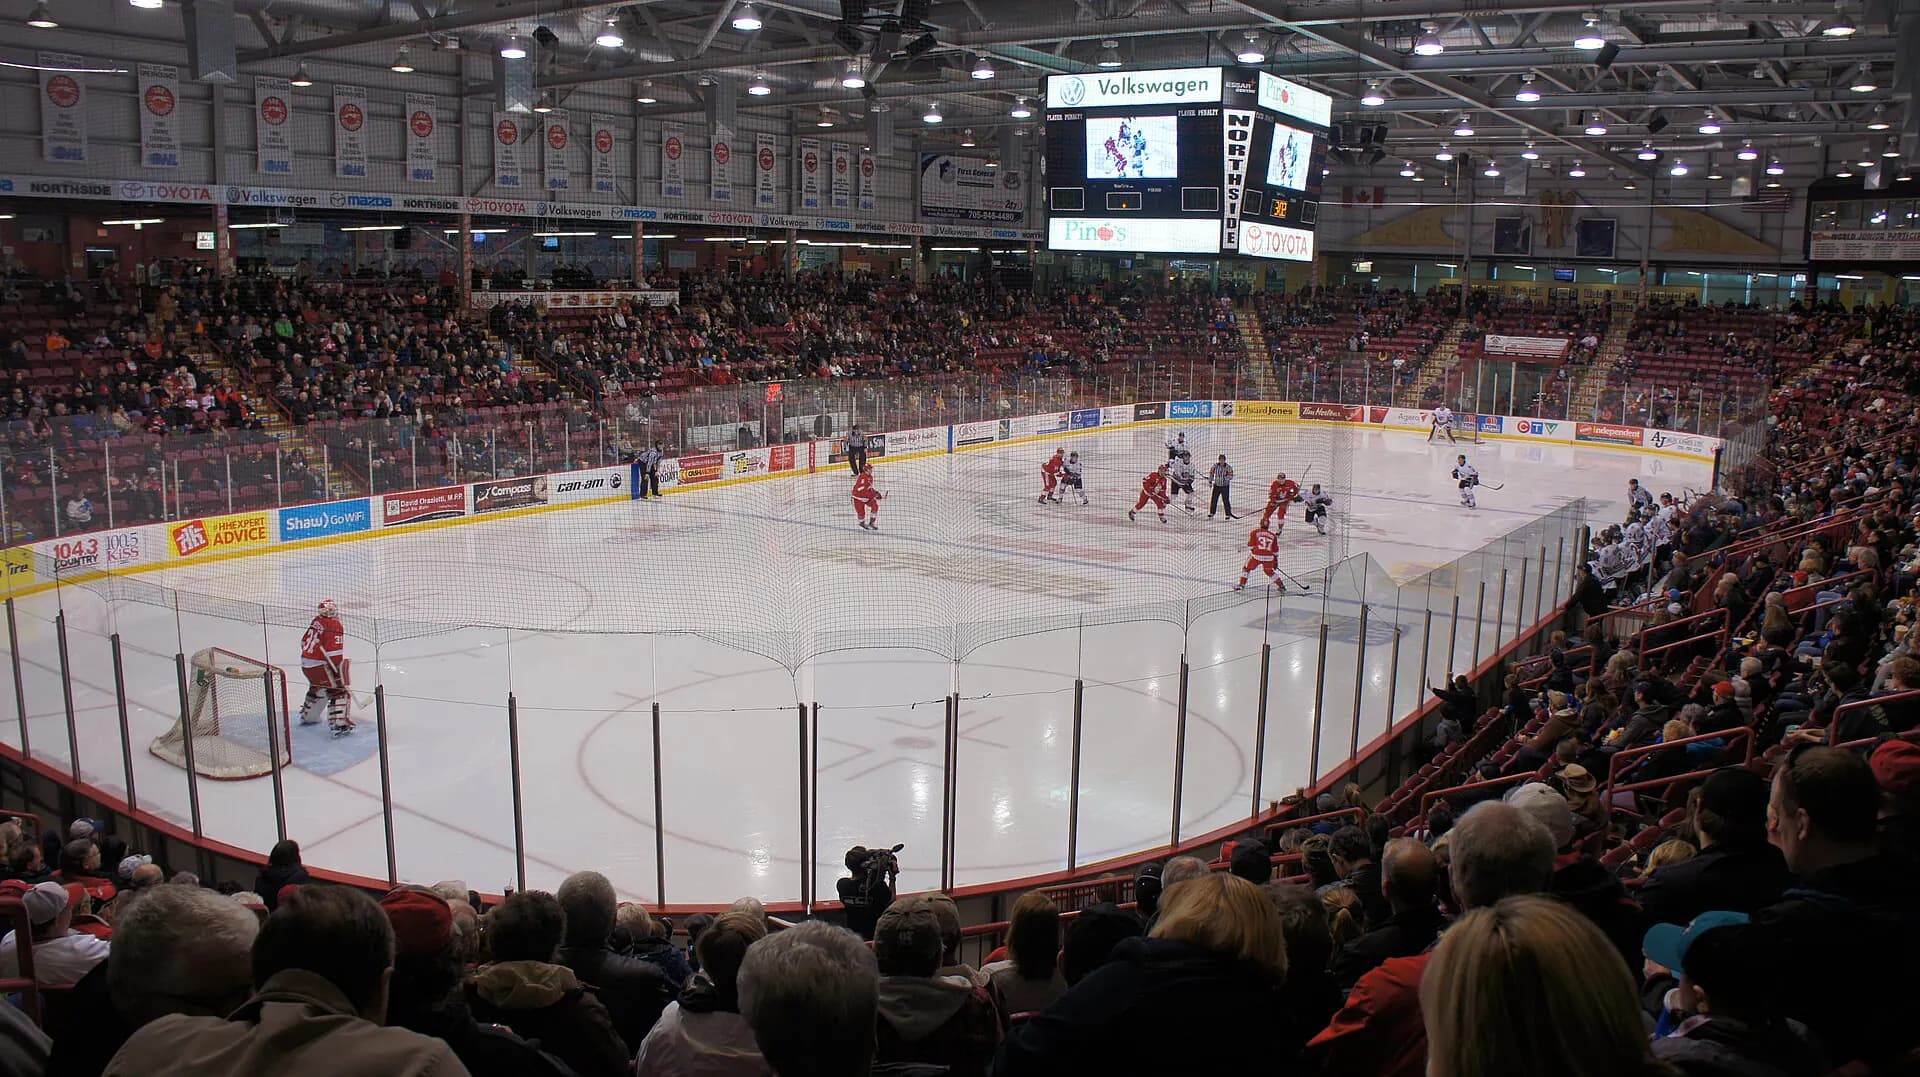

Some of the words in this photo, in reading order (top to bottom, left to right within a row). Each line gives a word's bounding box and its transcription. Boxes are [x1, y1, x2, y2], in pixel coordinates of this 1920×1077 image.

[1098, 77, 1208, 97] Volkswagen
[1227, 114, 1250, 244] NORTHSIDE
[30, 182, 112, 196] NORTHSIDE
[146, 185, 212, 200] TOYOTA
[241, 190, 317, 206] Volkswagen
[348, 195, 393, 207] mazda
[403, 199, 459, 210] NORTHSIDE
[483, 200, 526, 212] TOYOTA
[549, 204, 602, 217] Volkswagen
[624, 207, 657, 219] mazda
[663, 212, 704, 222] NORTHSIDE
[720, 213, 754, 223] TOYOTA
[825, 220, 850, 229] mazda
[898, 223, 925, 233] TOYOTA
[1266, 231, 1308, 255] TOYOTA
[1593, 426, 1640, 438] Independent
[491, 484, 532, 496] Compass
[557, 478, 604, 493] can-am
[106, 532, 139, 551] 100.5
[213, 527, 266, 546] ADVICE
[1257, 535, 1273, 550] 37
[53, 538, 99, 560] 104.3
[55, 554, 99, 570] COUNTRY
